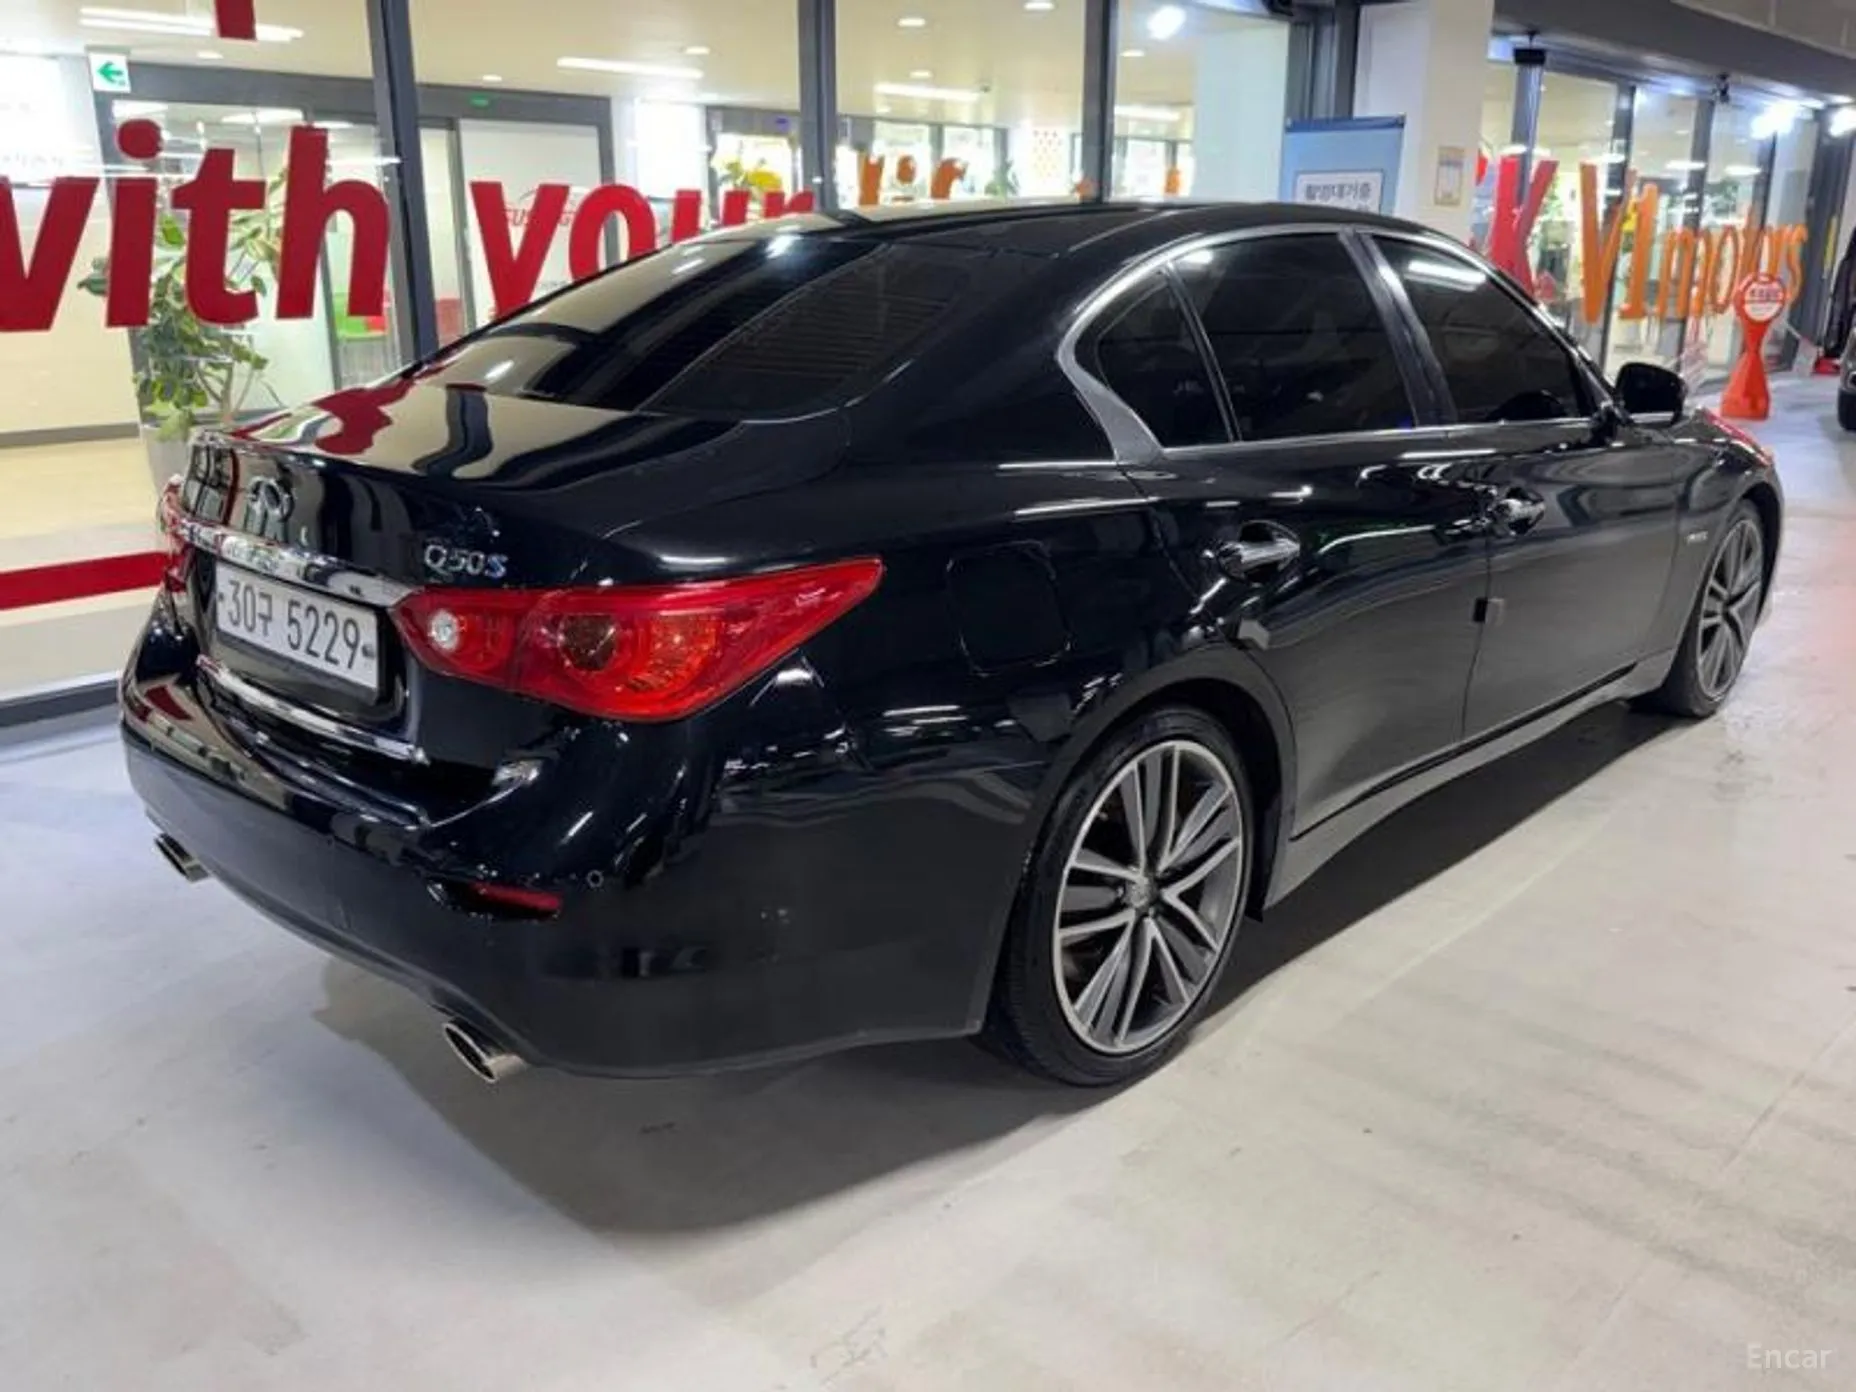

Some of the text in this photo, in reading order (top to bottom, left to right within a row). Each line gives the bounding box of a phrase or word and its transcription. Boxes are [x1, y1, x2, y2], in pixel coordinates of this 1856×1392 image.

[469, 181, 814, 321] yo
[424, 544, 509, 579] Q50S
[227, 579, 361, 670] 30구 5229
